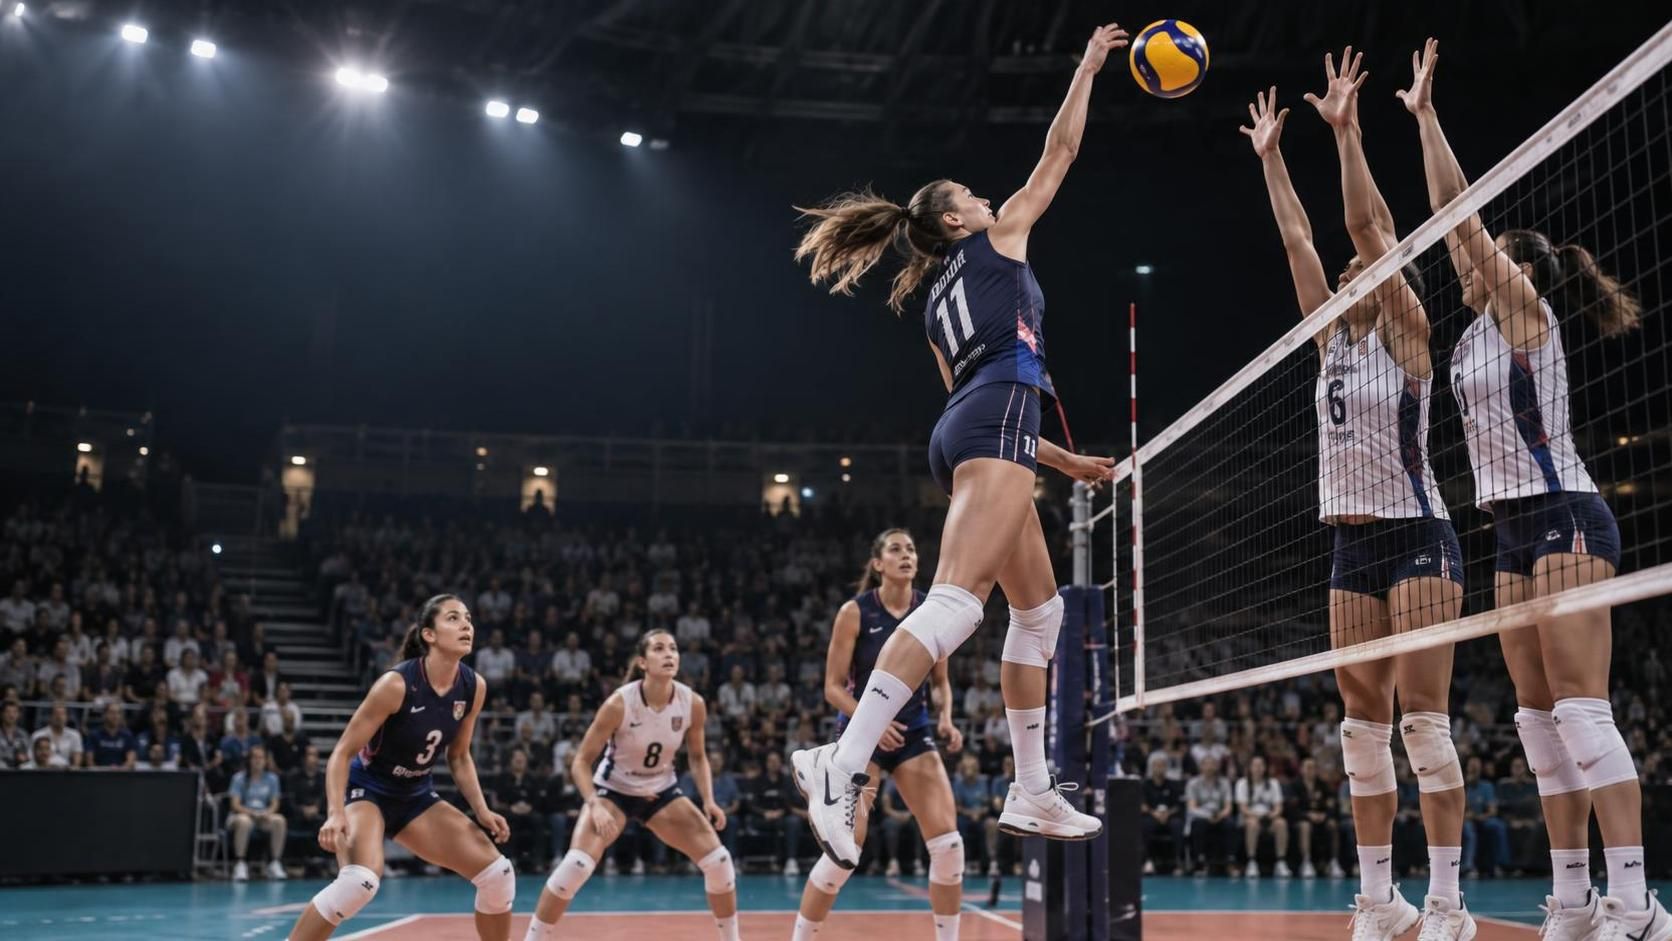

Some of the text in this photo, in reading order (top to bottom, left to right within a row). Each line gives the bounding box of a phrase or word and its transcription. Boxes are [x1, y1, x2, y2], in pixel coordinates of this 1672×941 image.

[936, 276, 975, 357] 11
[1327, 379, 1346, 426] 6
[1023, 434, 1036, 459] 11
[416, 729, 443, 766] 3
[643, 742, 663, 768] 8
